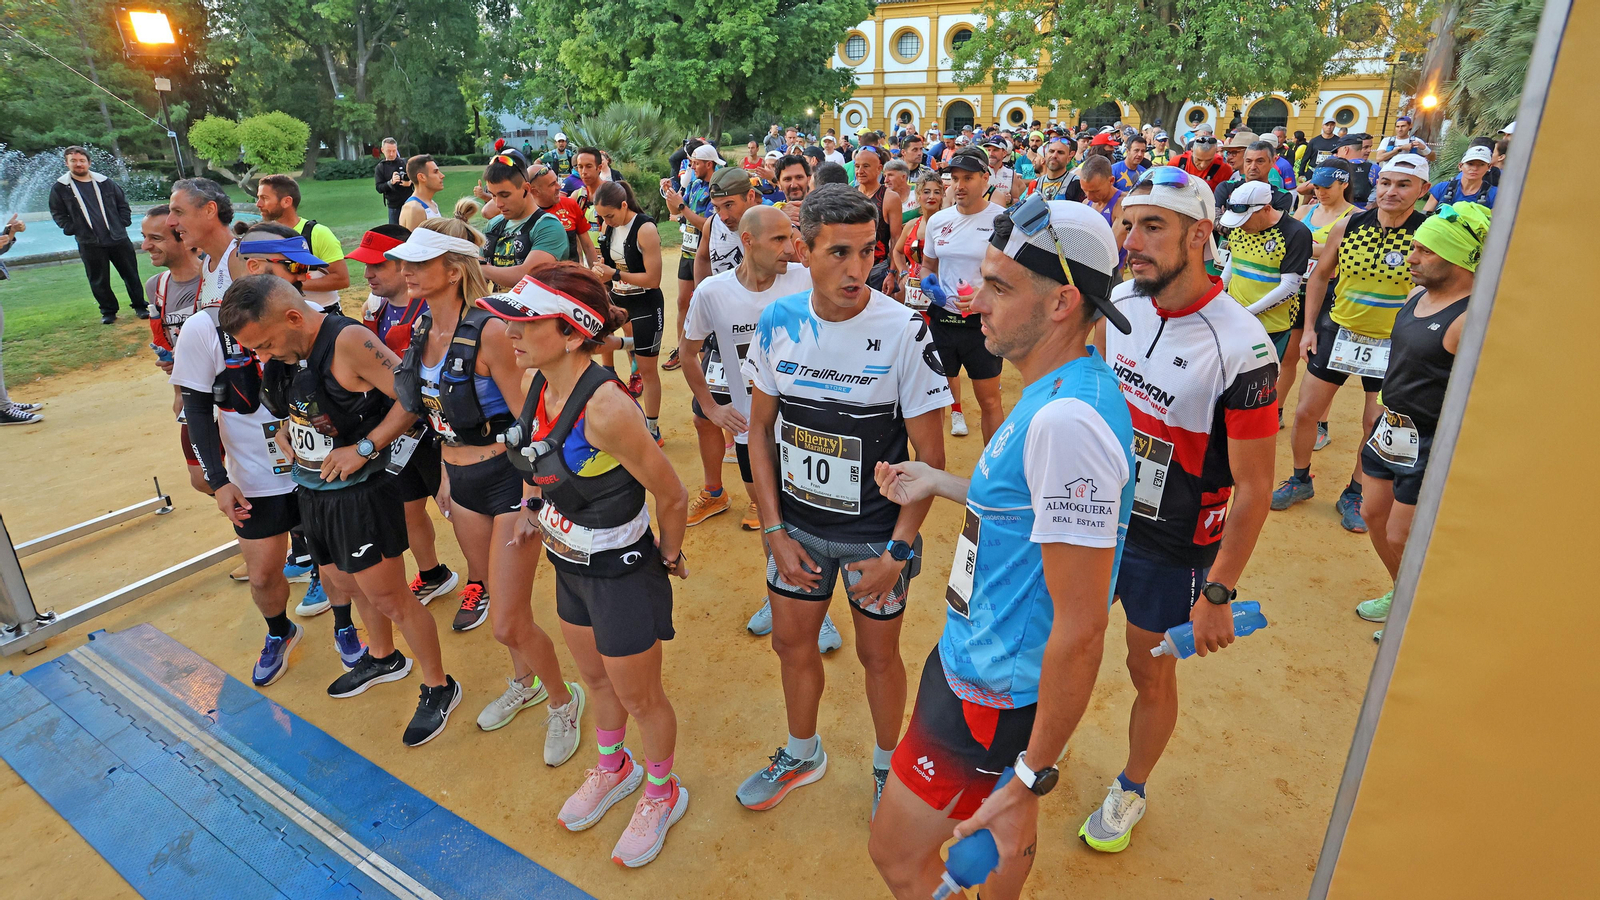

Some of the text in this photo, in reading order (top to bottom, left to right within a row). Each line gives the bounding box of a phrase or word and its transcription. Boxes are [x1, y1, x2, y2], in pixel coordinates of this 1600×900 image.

[908, 288, 924, 301] 147
[1116, 353, 1137, 368] CLUB
[1353, 345, 1373, 363] 15
[798, 365, 879, 386] TrailRunner
[824, 384, 847, 393] STORE
[926, 388, 941, 396] WE
[798, 430, 839, 454] Sherry
[802, 455, 831, 485] 10
[1045, 501, 1113, 515] ALMOGUERA
[1052, 516, 1106, 528] REAL ESTATE
[968, 638, 993, 646] G.A.B
[912, 764, 932, 783] mobel
